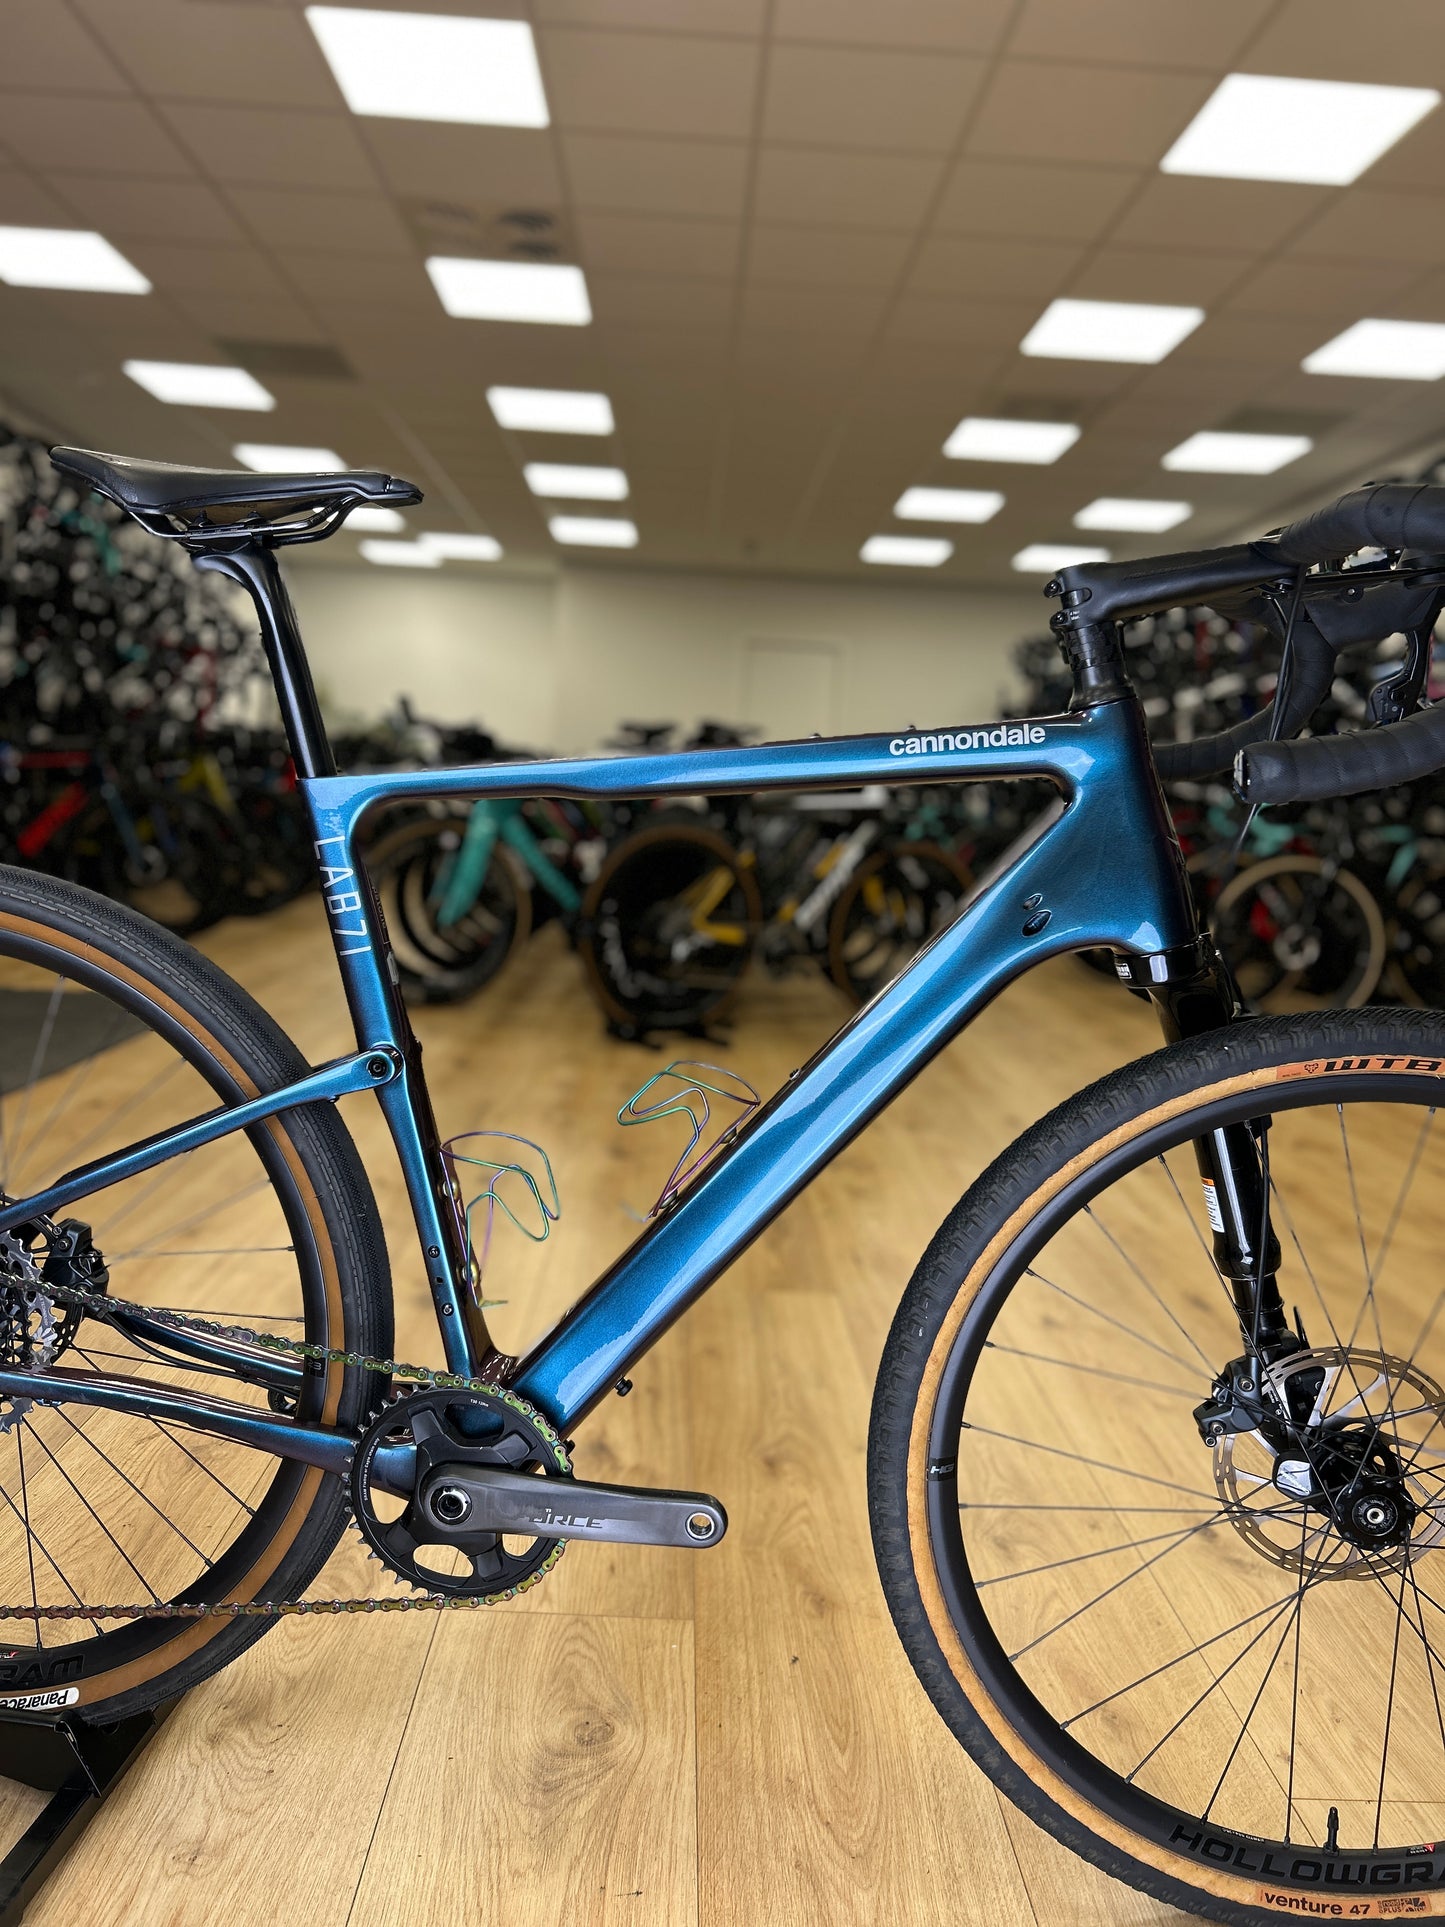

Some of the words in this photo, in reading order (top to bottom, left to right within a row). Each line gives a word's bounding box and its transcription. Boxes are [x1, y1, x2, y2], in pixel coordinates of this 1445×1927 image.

[889, 723, 1046, 756] cannondale
[314, 835, 372, 956] LAB71
[1324, 1058, 1442, 1072] WTB
[1264, 1892, 1343, 1916] venture
[1350, 1903, 1371, 1916] 47
